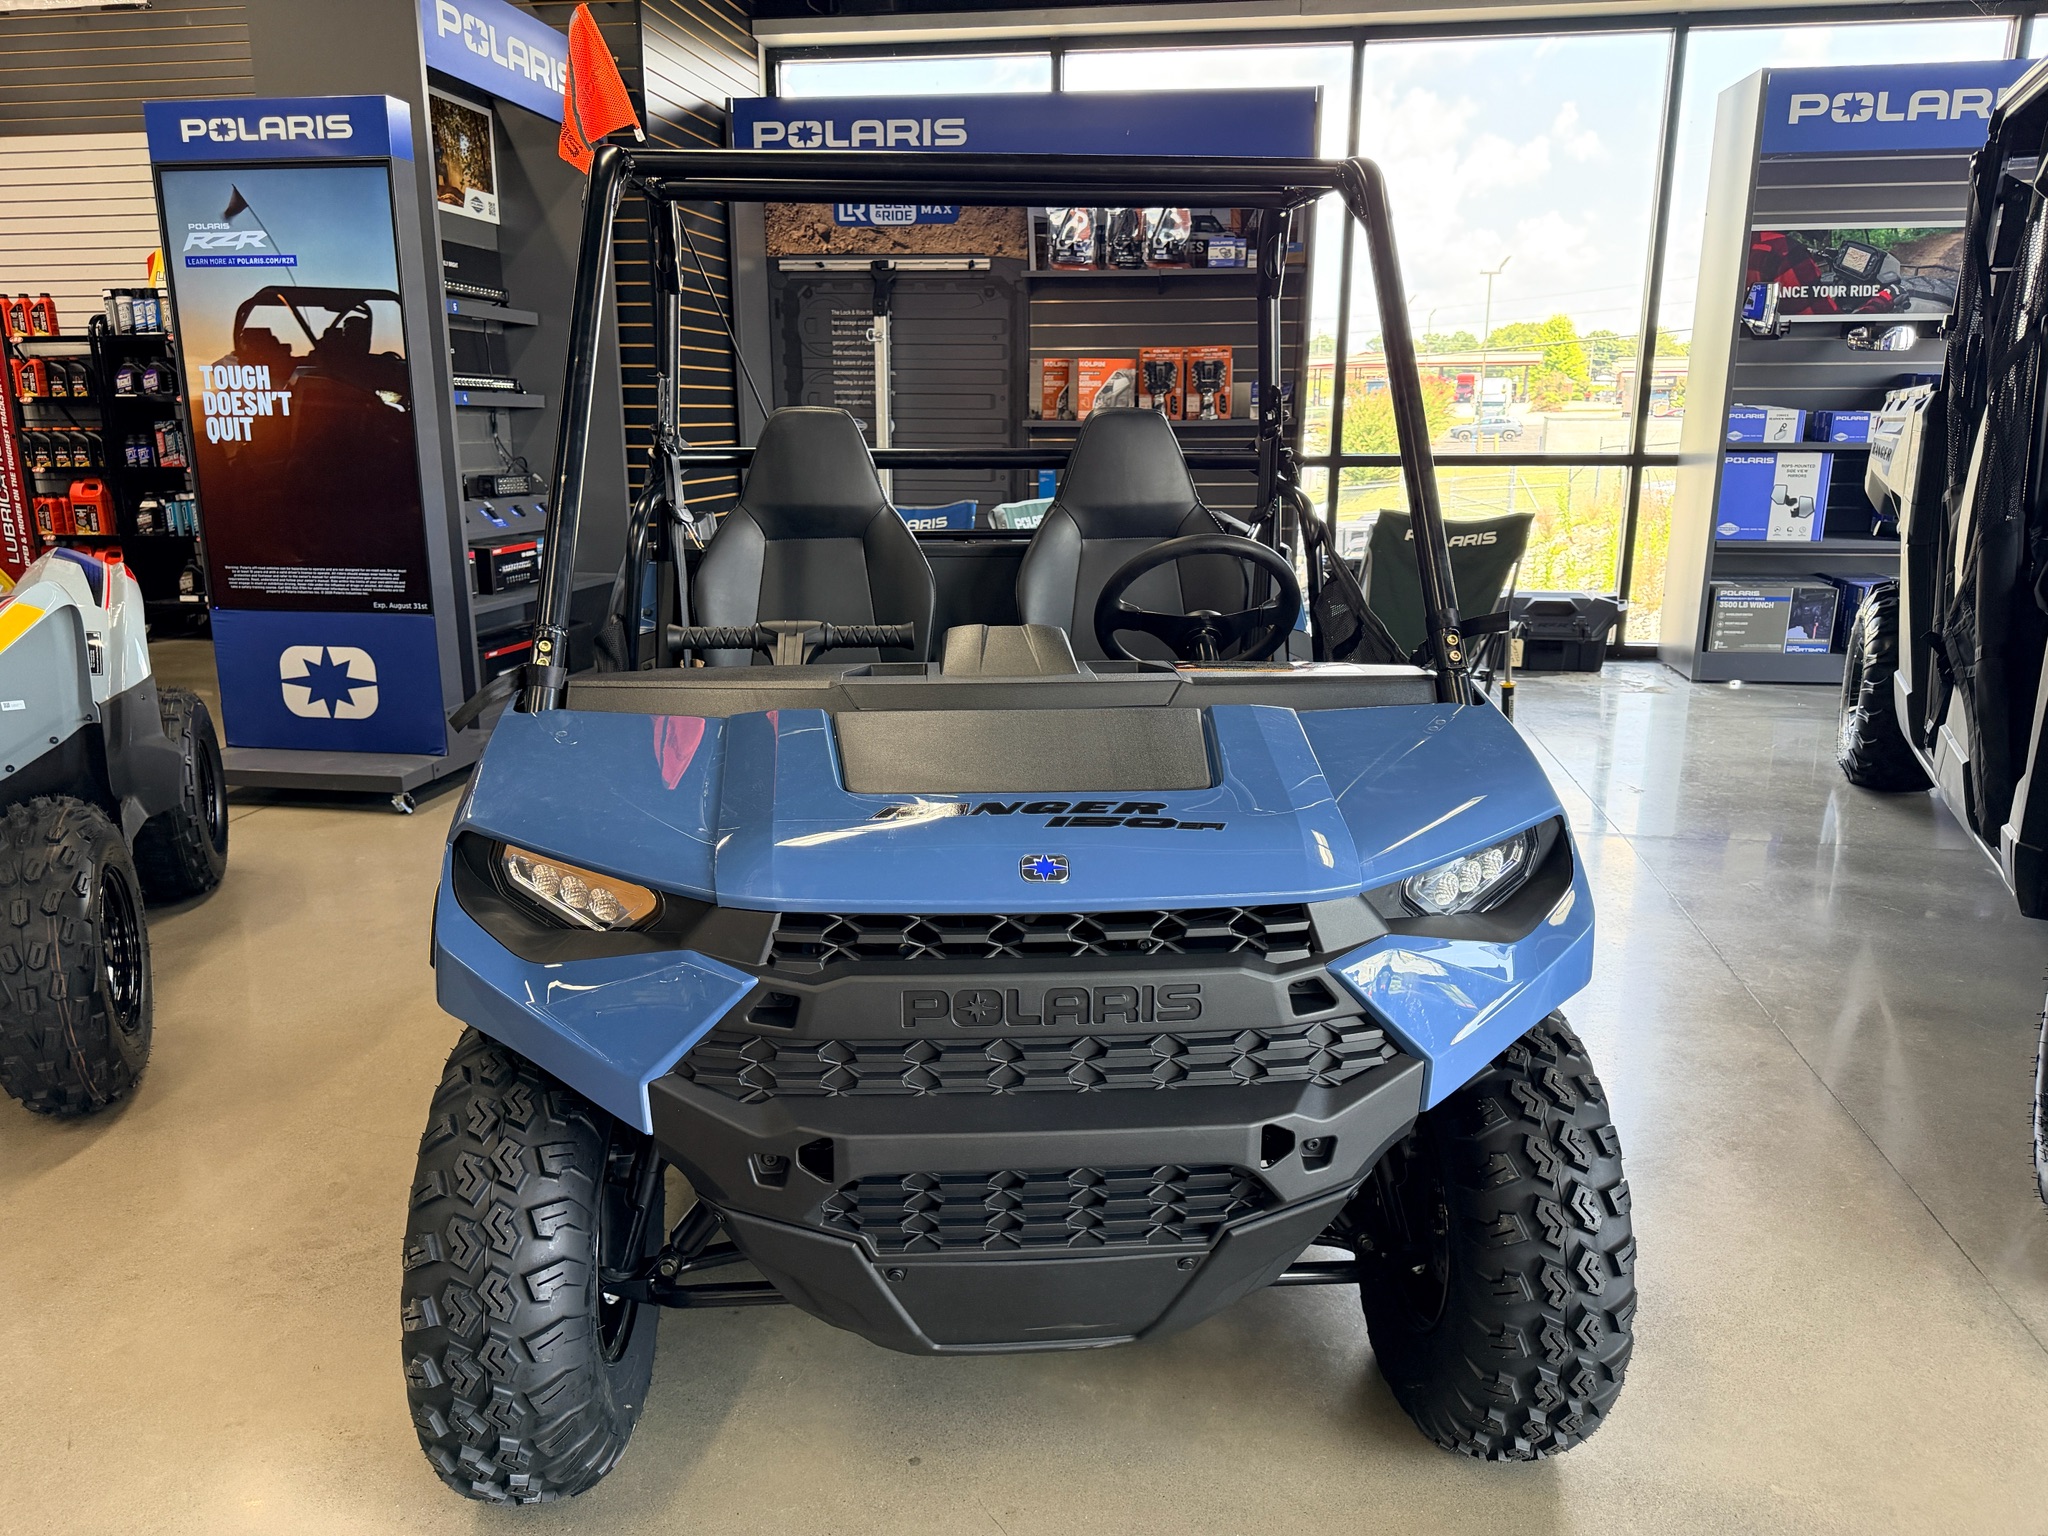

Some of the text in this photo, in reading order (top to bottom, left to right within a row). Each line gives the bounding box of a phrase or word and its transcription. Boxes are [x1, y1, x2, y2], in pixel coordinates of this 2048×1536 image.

[1788, 88, 2007, 125] POLAR
[180, 114, 353, 143] POLARIS
[752, 118, 968, 149] POLARIS
[920, 204, 953, 215] MAX
[188, 222, 230, 230] POLARIS
[183, 230, 268, 252] RZR
[187, 258, 208, 266] LEARN
[237, 257, 295, 265] POLARIS.COM/RZR
[1812, 285, 1847, 297] YOUR
[1850, 284, 1880, 297] RIDE
[199, 365, 271, 390] TOUGH
[203, 391, 292, 417] DOESN'T
[206, 417, 254, 444] QUIT
[3, 429, 16, 471] TOUGHEST
[9, 472, 18, 488] THE
[12, 489, 20, 502] ON
[15, 502, 26, 535] PROVEN
[908, 516, 948, 529] ARIS
[1404, 529, 1498, 548] PARIS
[373, 601, 429, 610] Exp. August 31st
[1042, 816, 1181, 830] 150
[901, 984, 1203, 1029] POLARIS
